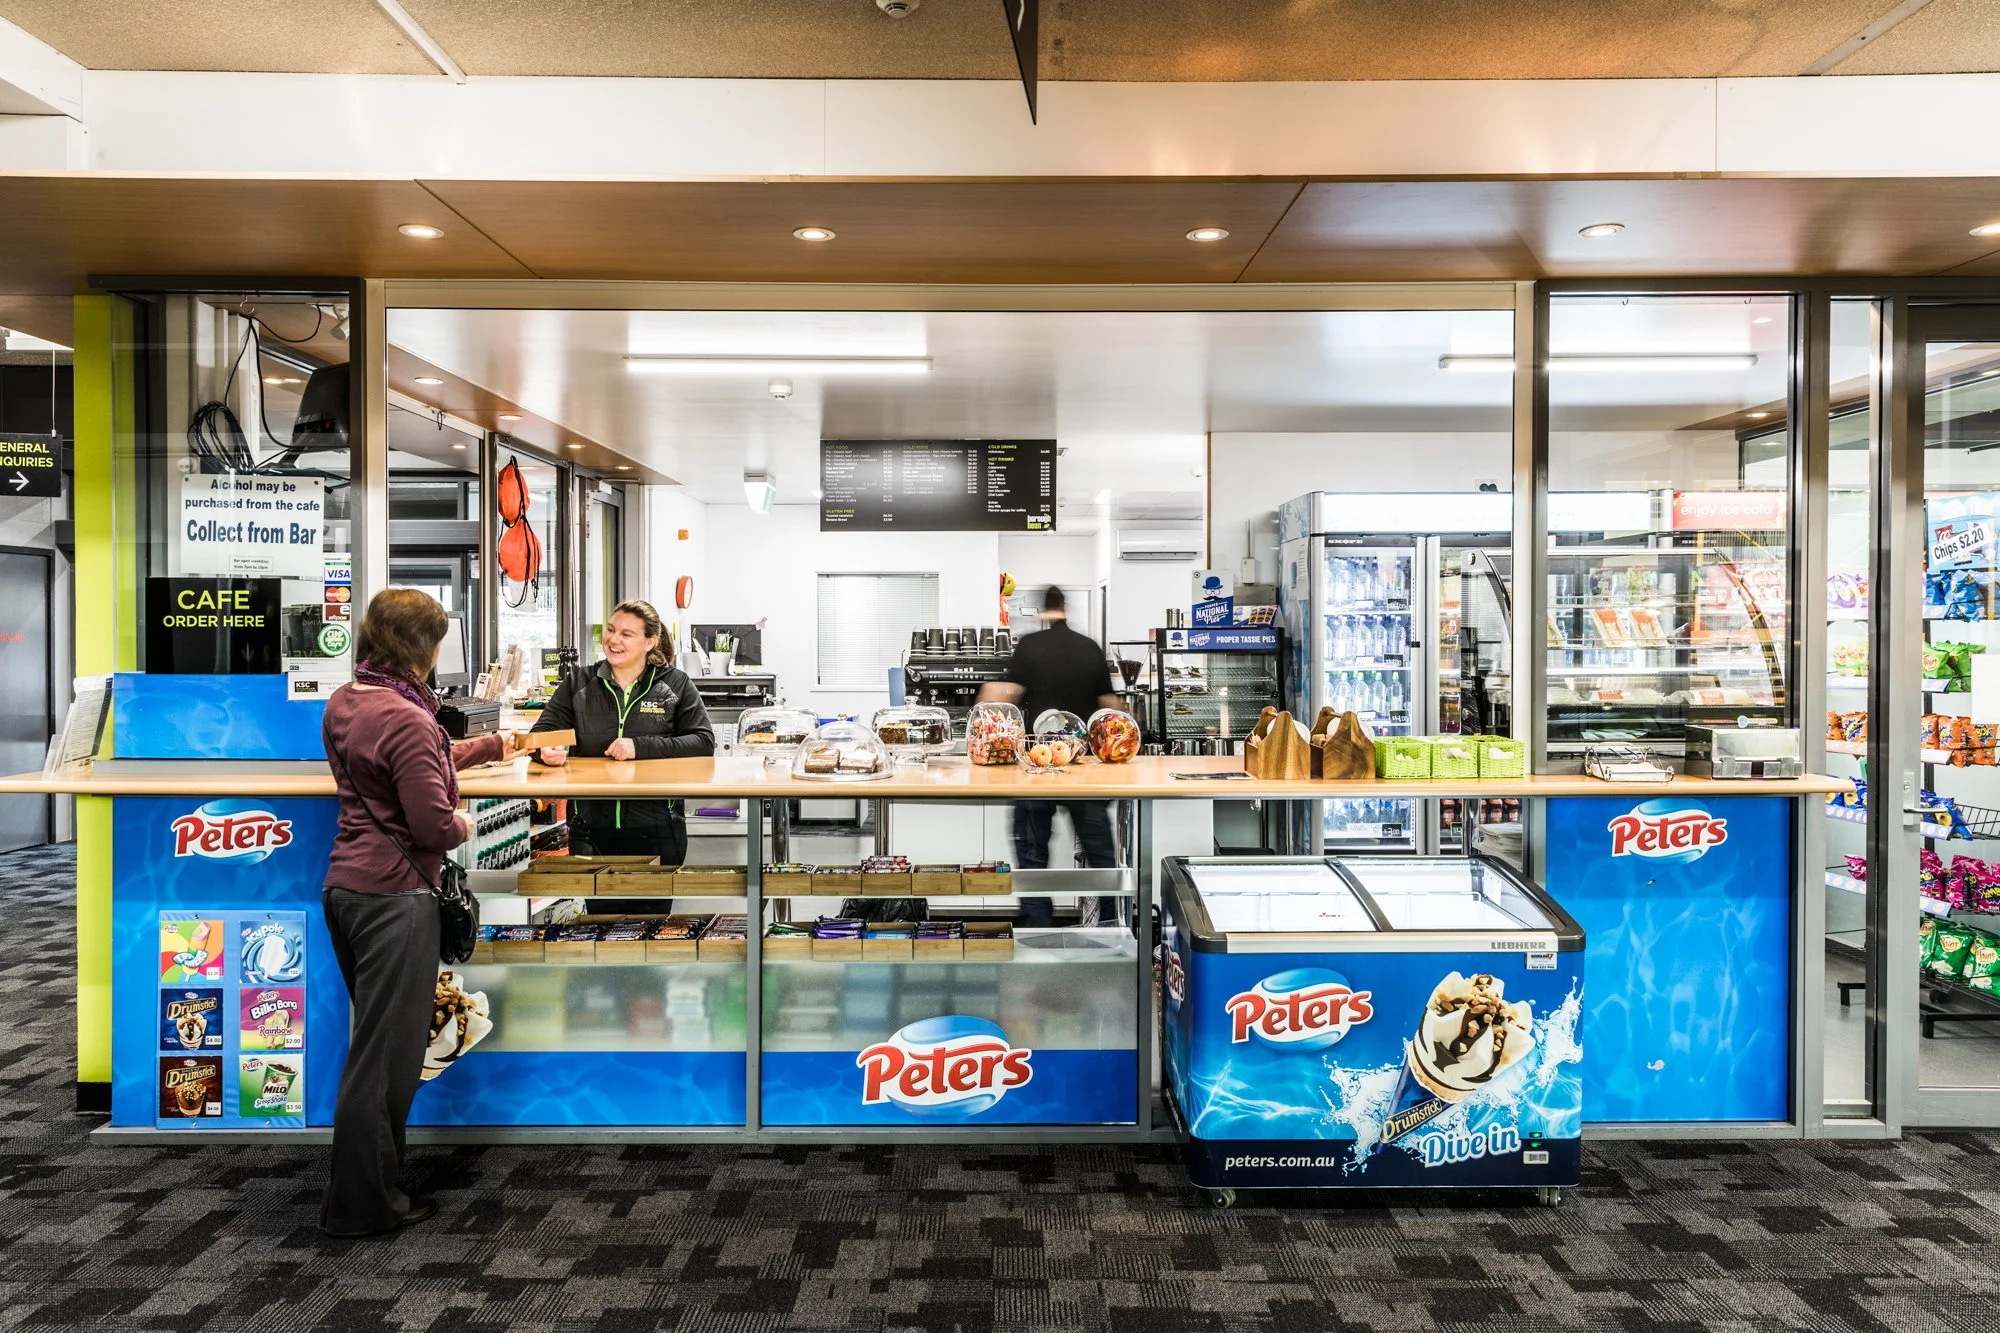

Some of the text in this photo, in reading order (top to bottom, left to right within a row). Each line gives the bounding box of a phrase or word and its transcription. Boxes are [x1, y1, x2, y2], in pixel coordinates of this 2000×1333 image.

[0, 442, 50, 453] ENERAL
[0, 456, 54, 468] QUIRIES
[210, 478, 296, 494] Alcohol may be
[185, 498, 320, 510] purchased from the cafe
[1681, 505, 1717, 517] enjoy
[1743, 504, 1772, 515] cold
[187, 519, 316, 544] Collect from Bar
[1934, 528, 1984, 560] Chips $2.20
[328, 570, 350, 578] VISA
[177, 590, 250, 610] CAFE
[1196, 604, 1229, 620] NATIONAL
[162, 615, 265, 627] ORDER HERE
[172, 814, 292, 855] Peters
[1609, 814, 1726, 855] Peters
[1491, 941, 1546, 949] LIEBHERR
[1164, 948, 1184, 1000] Peters
[258, 992, 279, 1002] Peters
[171, 1000, 216, 1018] Drumstick
[1227, 988, 1372, 1041] Peters
[258, 1025, 292, 1038] Rainbow
[242, 1061, 263, 1071] Peters
[858, 1042, 1031, 1101] Peters
[170, 1066, 214, 1085] Drumstick
[1382, 1100, 1440, 1140] Drumstick
[1422, 1124, 1518, 1164] Dive in
[1225, 1154, 1335, 1170] peters.com.au
